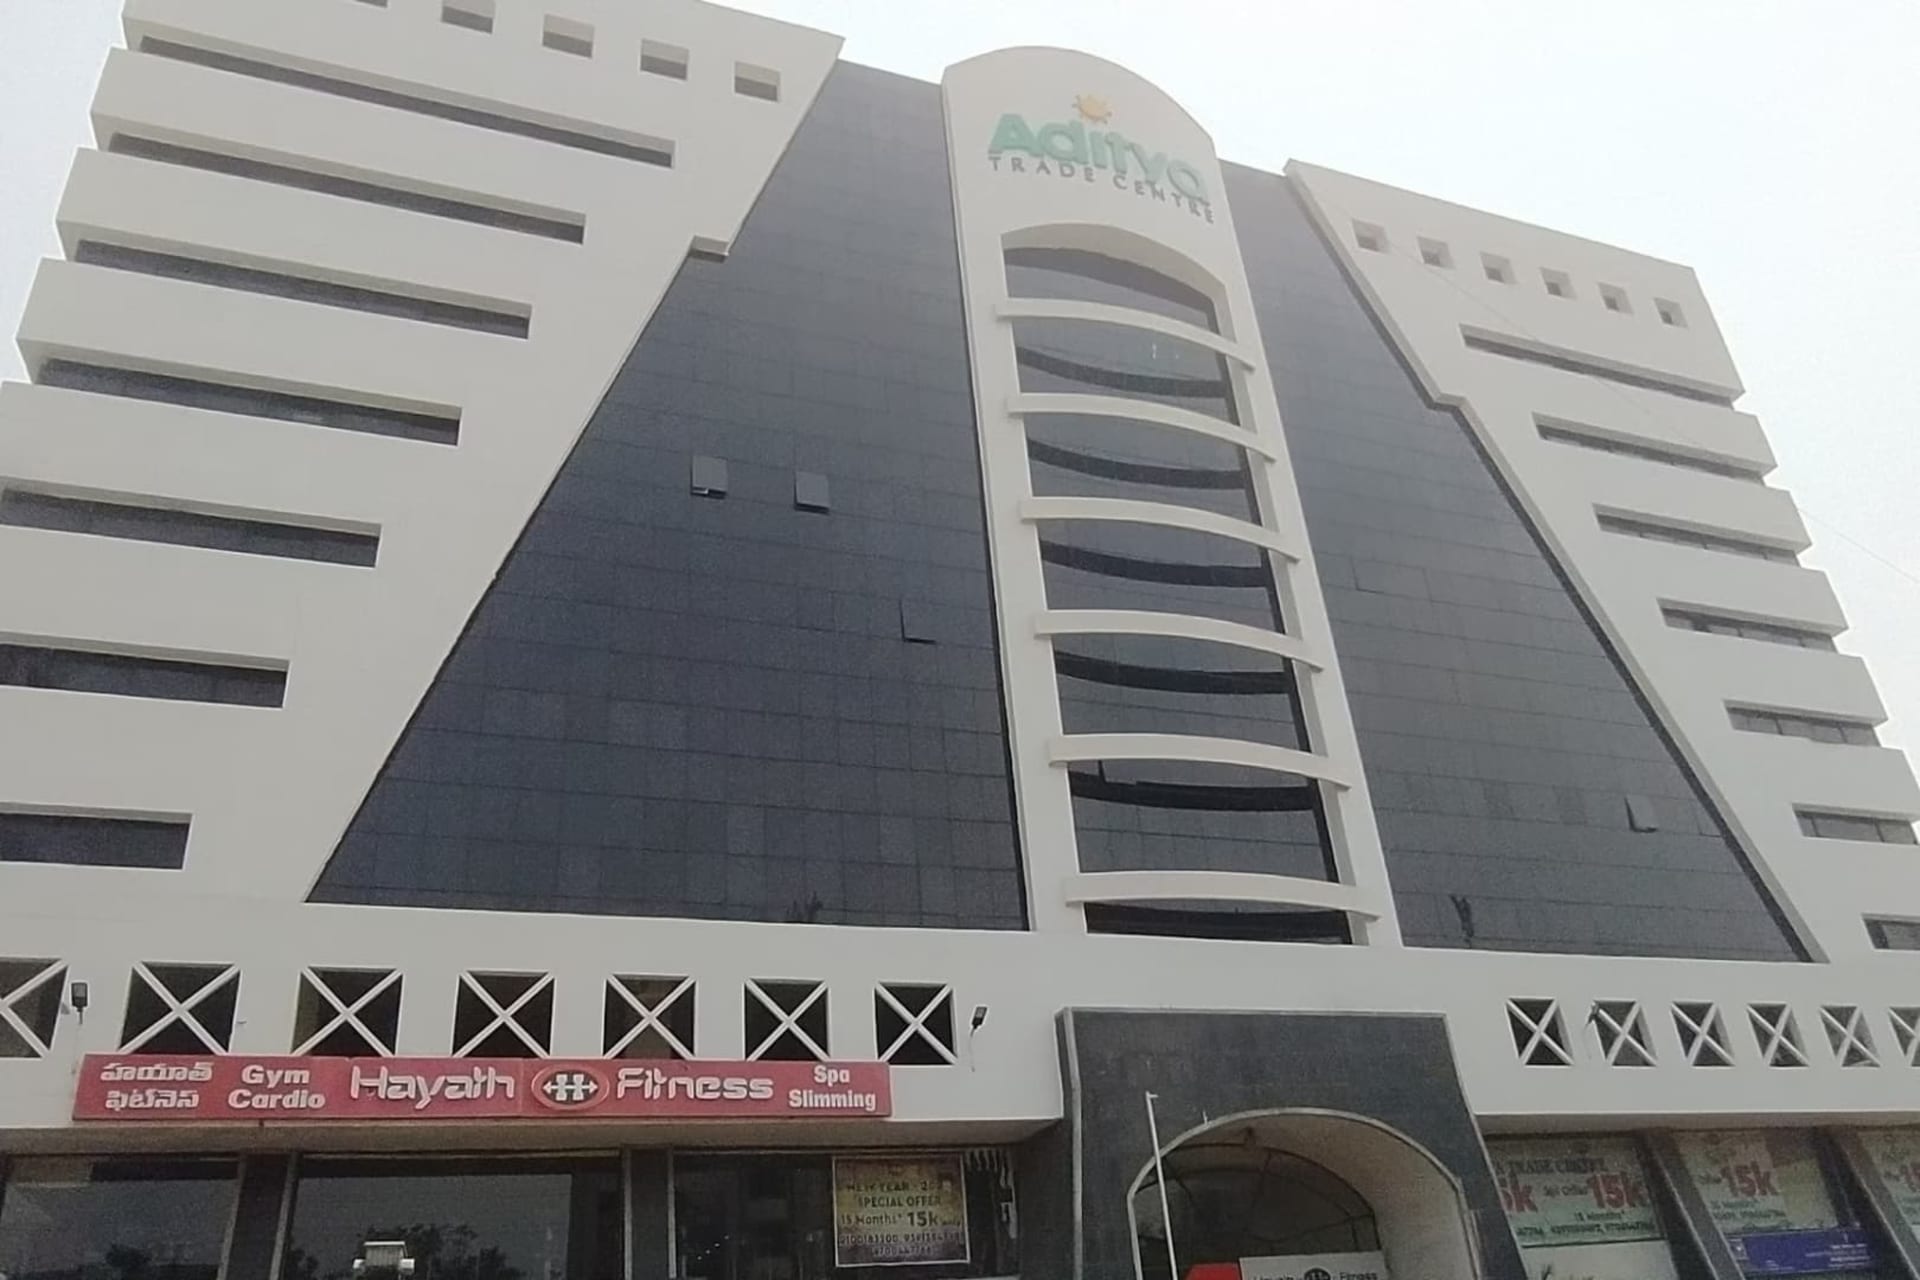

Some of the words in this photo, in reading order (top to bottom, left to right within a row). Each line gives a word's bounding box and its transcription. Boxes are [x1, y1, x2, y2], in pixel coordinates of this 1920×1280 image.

[988, 113, 1210, 209] Aditya
[988, 155, 1096, 183] TRADE
[1112, 174, 1215, 225] CENTRE
[241, 1064, 310, 1088] Gym
[813, 1064, 850, 1085] Spa
[228, 1088, 326, 1110] Cardio
[350, 1065, 515, 1110] Hayath
[616, 1066, 774, 1100] Fitness
[789, 1089, 876, 1112] Slimming
[906, 1194, 942, 1207] OFFER
